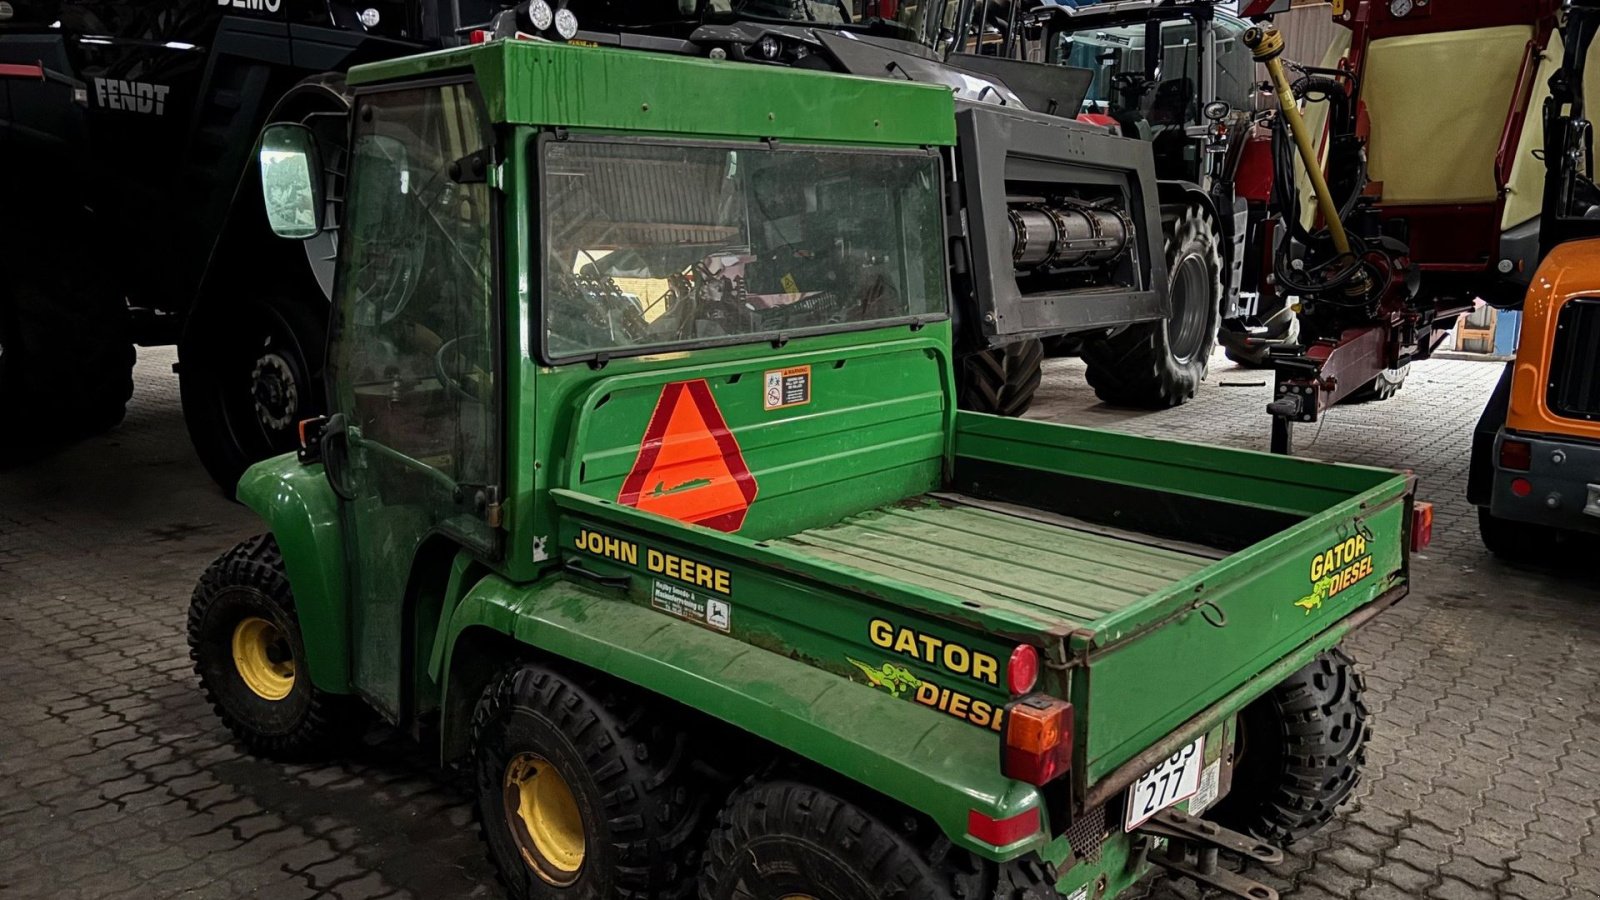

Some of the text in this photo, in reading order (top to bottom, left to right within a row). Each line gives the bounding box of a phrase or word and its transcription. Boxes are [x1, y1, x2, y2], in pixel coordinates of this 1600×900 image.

[94, 77, 170, 116] FENDT
[575, 529, 731, 594] JOHN DEERE
[1310, 533, 1366, 582] GATOR
[1328, 555, 1374, 597] DIESEL
[869, 619, 998, 685] GATOR
[916, 681, 1004, 731] DIES
[1143, 766, 1185, 815] 277
